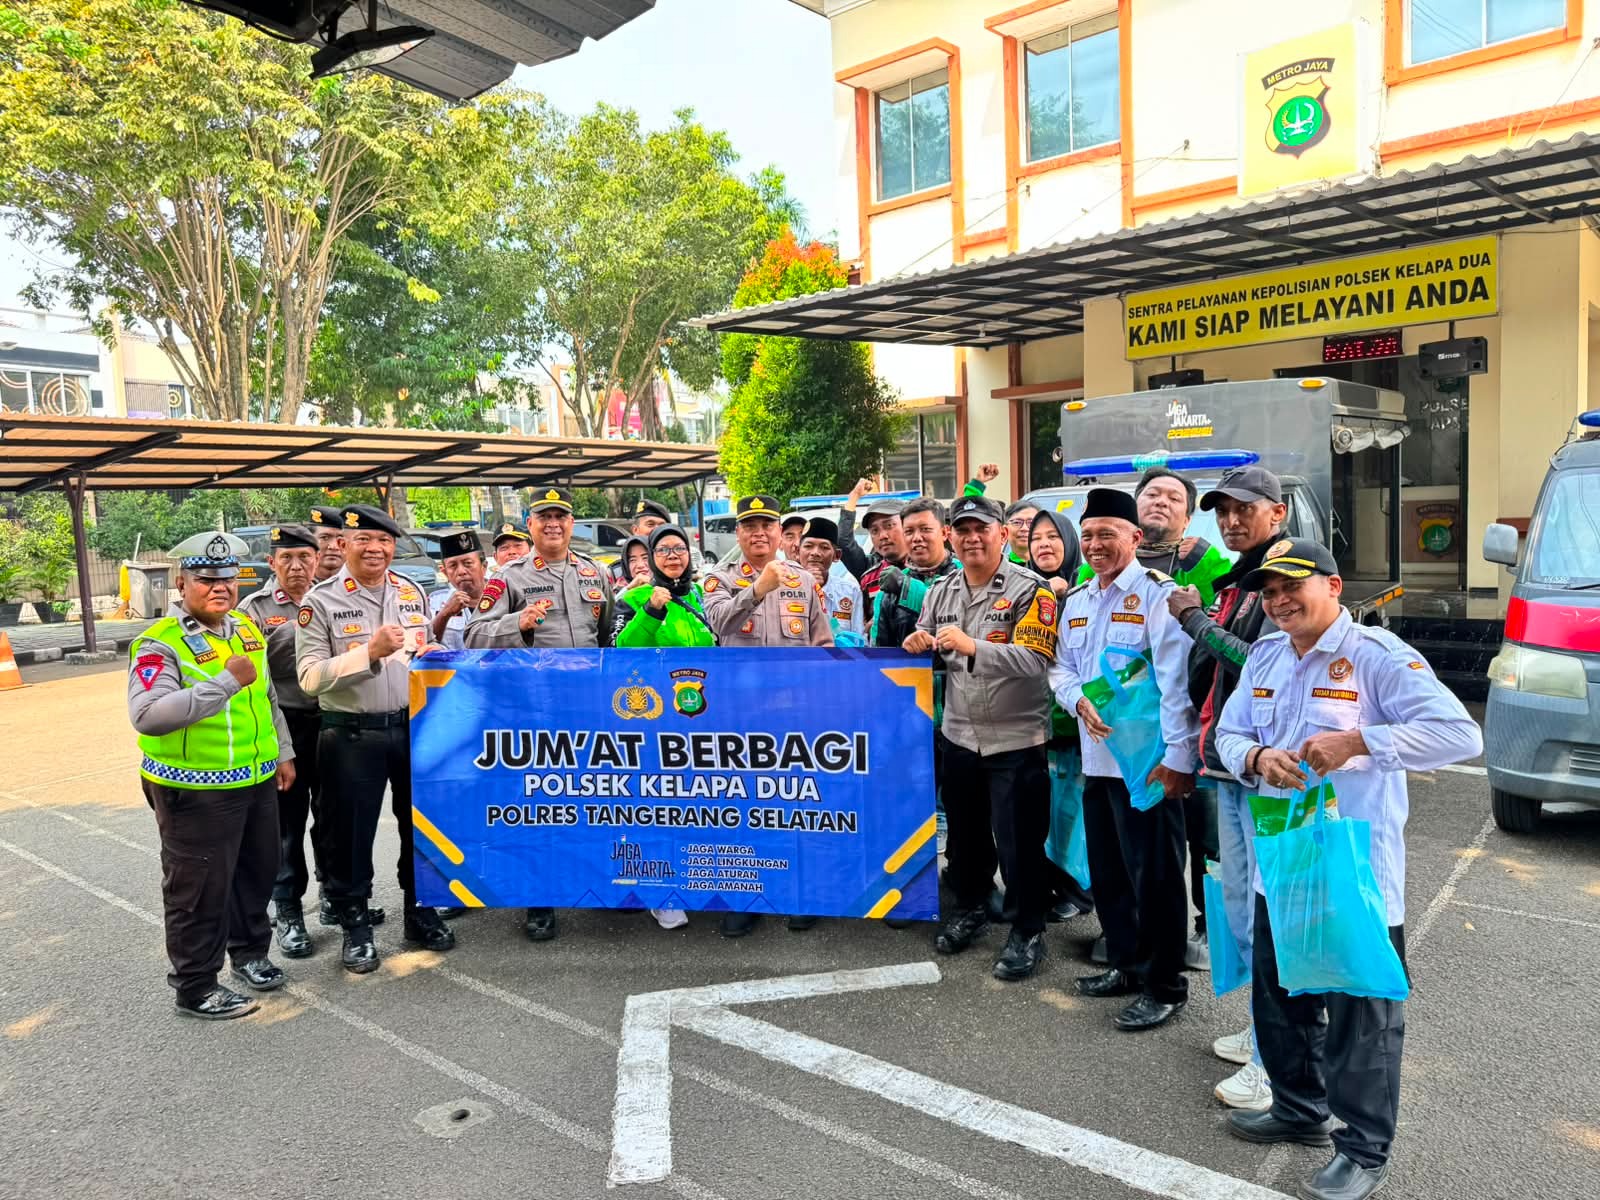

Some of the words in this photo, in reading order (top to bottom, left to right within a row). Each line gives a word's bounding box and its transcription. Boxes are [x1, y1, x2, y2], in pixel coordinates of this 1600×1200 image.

[1266, 64, 1302, 86] METRO
[1304, 60, 1329, 72] JAYA
[1128, 304, 1174, 320] SENTRA
[1176, 290, 1248, 312] PELAYANAN
[1251, 277, 1331, 299] KEPOLISIAN
[1334, 266, 1392, 288] POLSEK
[1396, 256, 1454, 278] KELAPA
[1459, 252, 1492, 270] DUA
[1128, 319, 1187, 348] KAMI
[1194, 310, 1250, 338] SIAP
[1259, 288, 1395, 331] MELAYANI
[1405, 275, 1490, 311] ANDA
[1165, 401, 1188, 416] JAGA
[780, 591, 807, 599] POLRI
[473, 729, 645, 770] JUM'AT
[659, 730, 869, 774] BERBAGI
[524, 772, 633, 798] POLSEK
[639, 773, 748, 801] KELAPA
[756, 775, 821, 802] DUA
[486, 805, 578, 827] POLRES
[586, 806, 740, 829] TANGERANG
[747, 807, 857, 833] SELATAN
[610, 841, 641, 860] JAGA
[687, 844, 715, 855] JAGA
[717, 845, 755, 856] WARGA
[687, 856, 715, 867] JAGA
[717, 857, 788, 869] LINGKUNGAN
[687, 869, 715, 879] JAGA
[717, 869, 759, 880] ATURAN
[687, 881, 715, 891] JAGA
[717, 882, 764, 893] AMANAH
